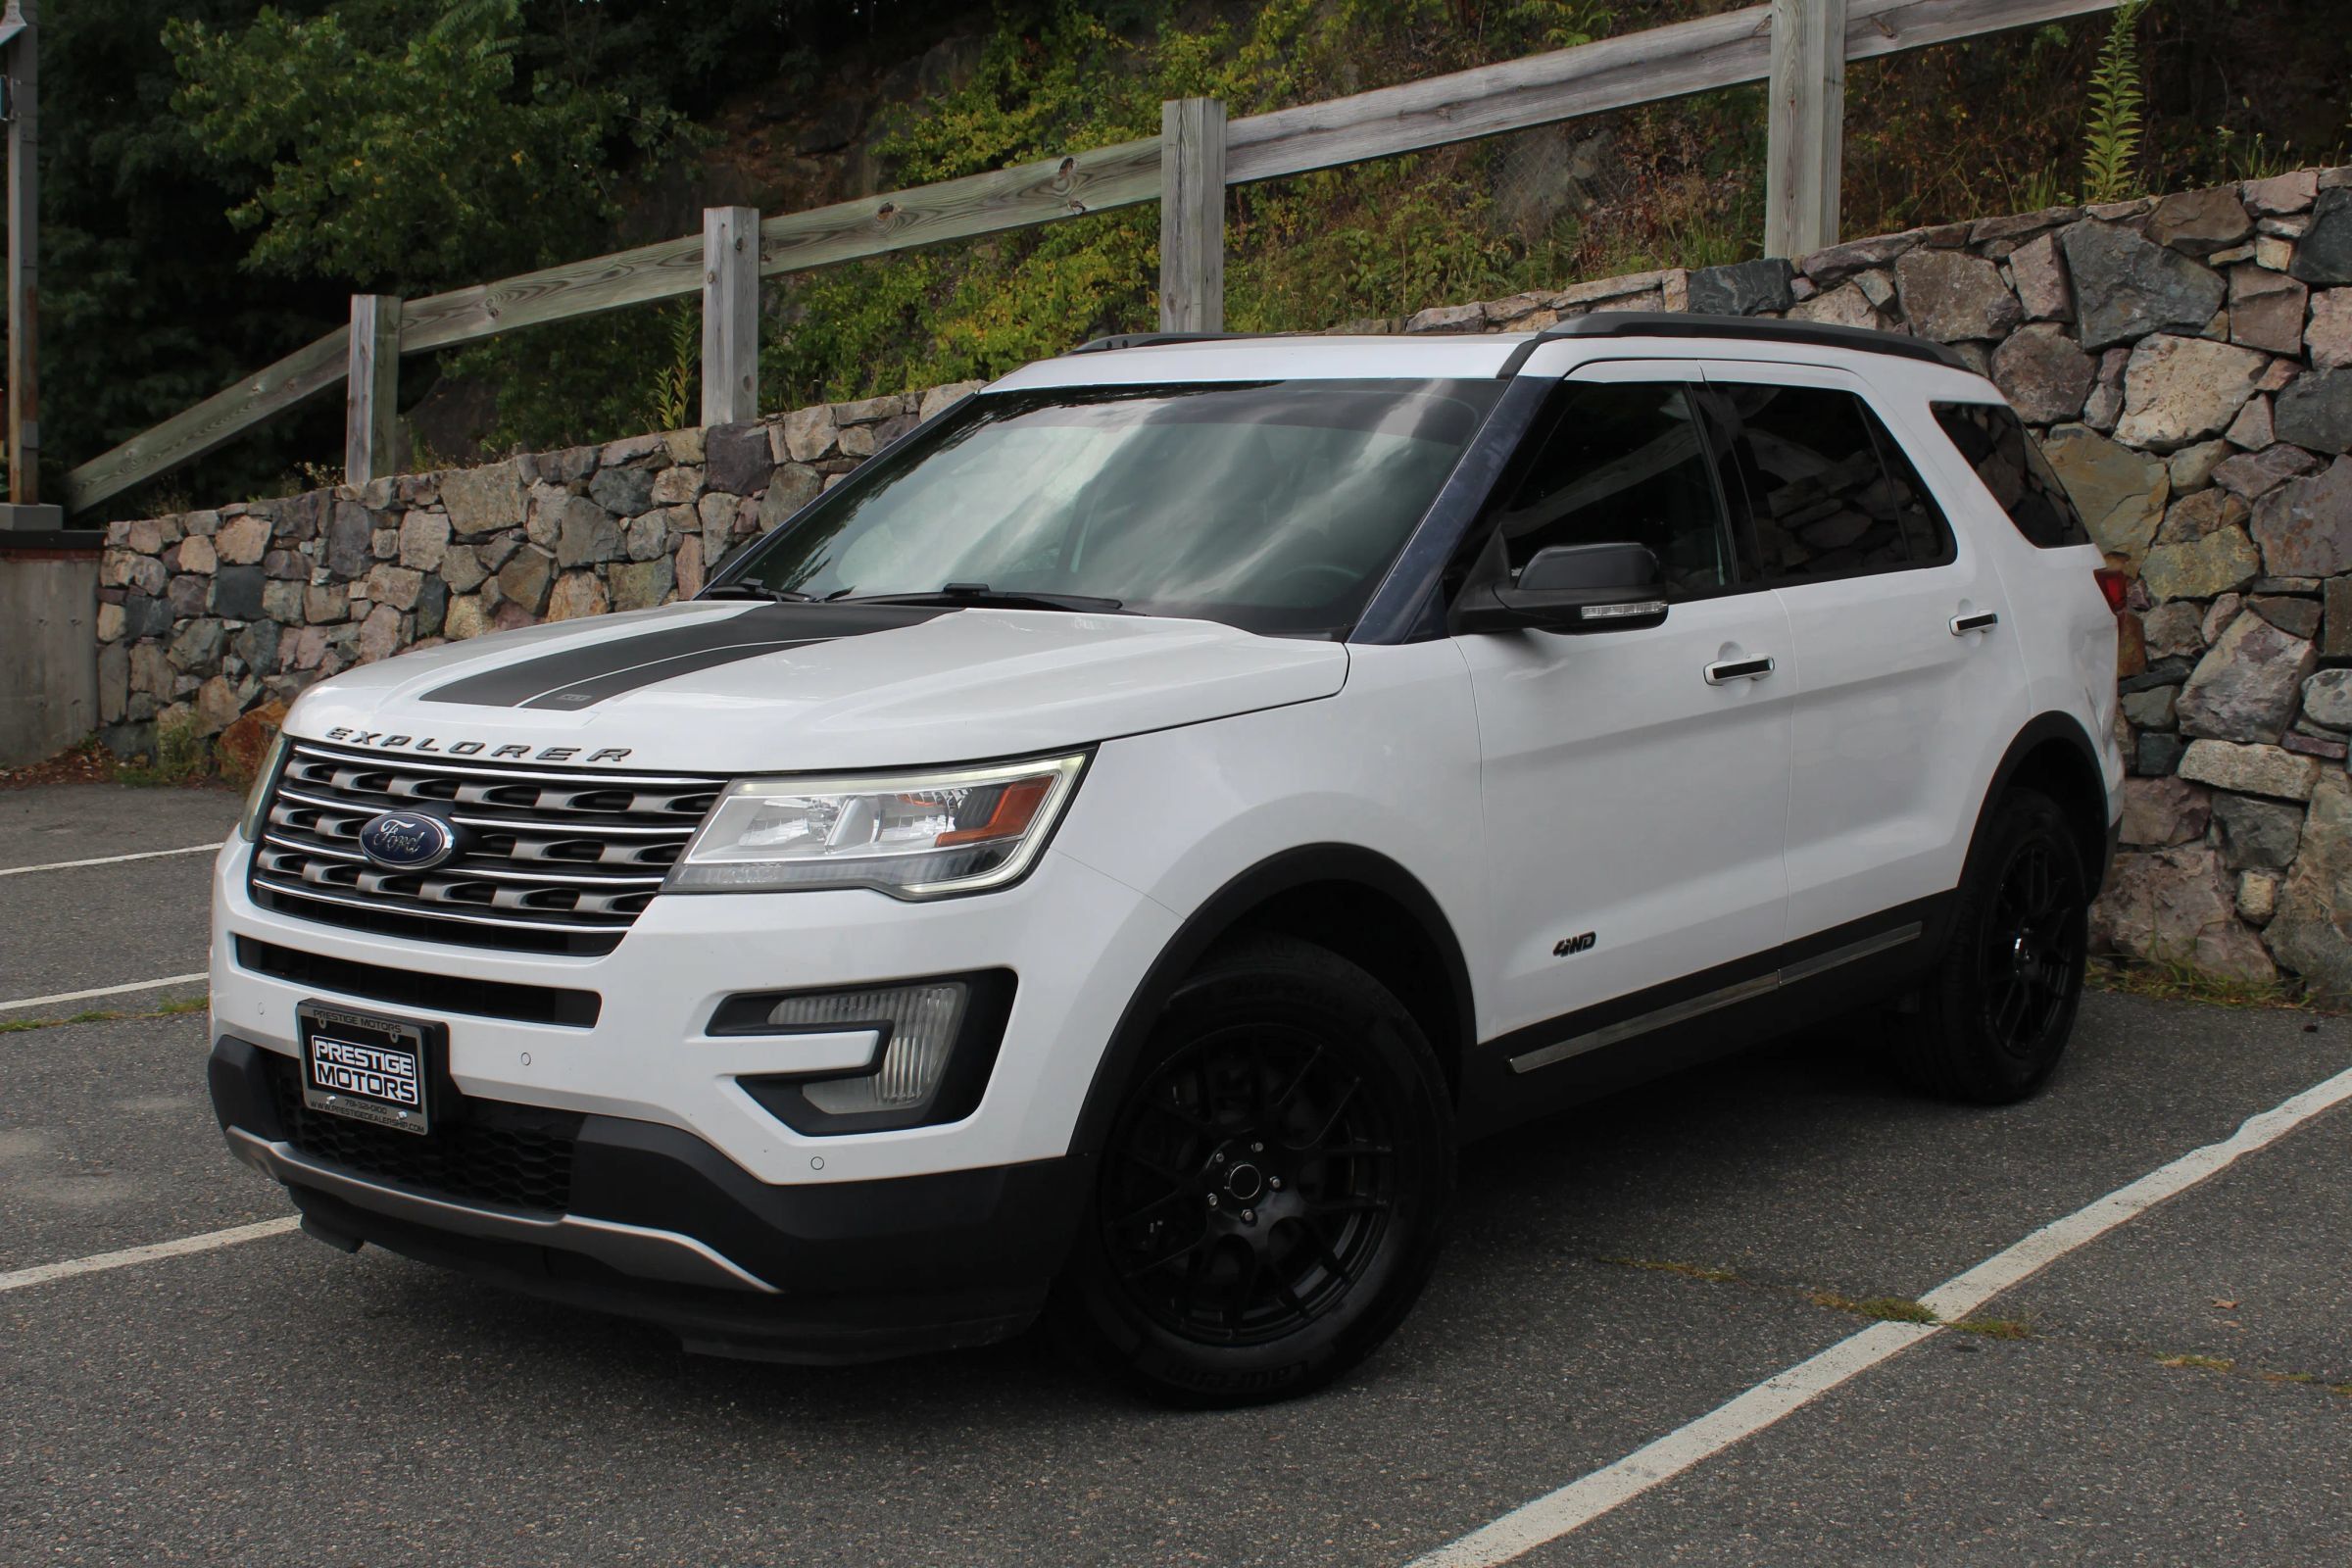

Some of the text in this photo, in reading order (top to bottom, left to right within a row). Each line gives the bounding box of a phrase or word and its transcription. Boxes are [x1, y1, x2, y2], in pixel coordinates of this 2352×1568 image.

[325, 726, 633, 762] EXPLORER
[371, 819, 426, 855] Ford
[1552, 931, 1596, 957] 4WD
[313, 1009, 402, 1034] PRESTIGE MOTORS
[315, 1040, 414, 1077] PRESTIGE
[318, 1063, 416, 1102] MOTORS
